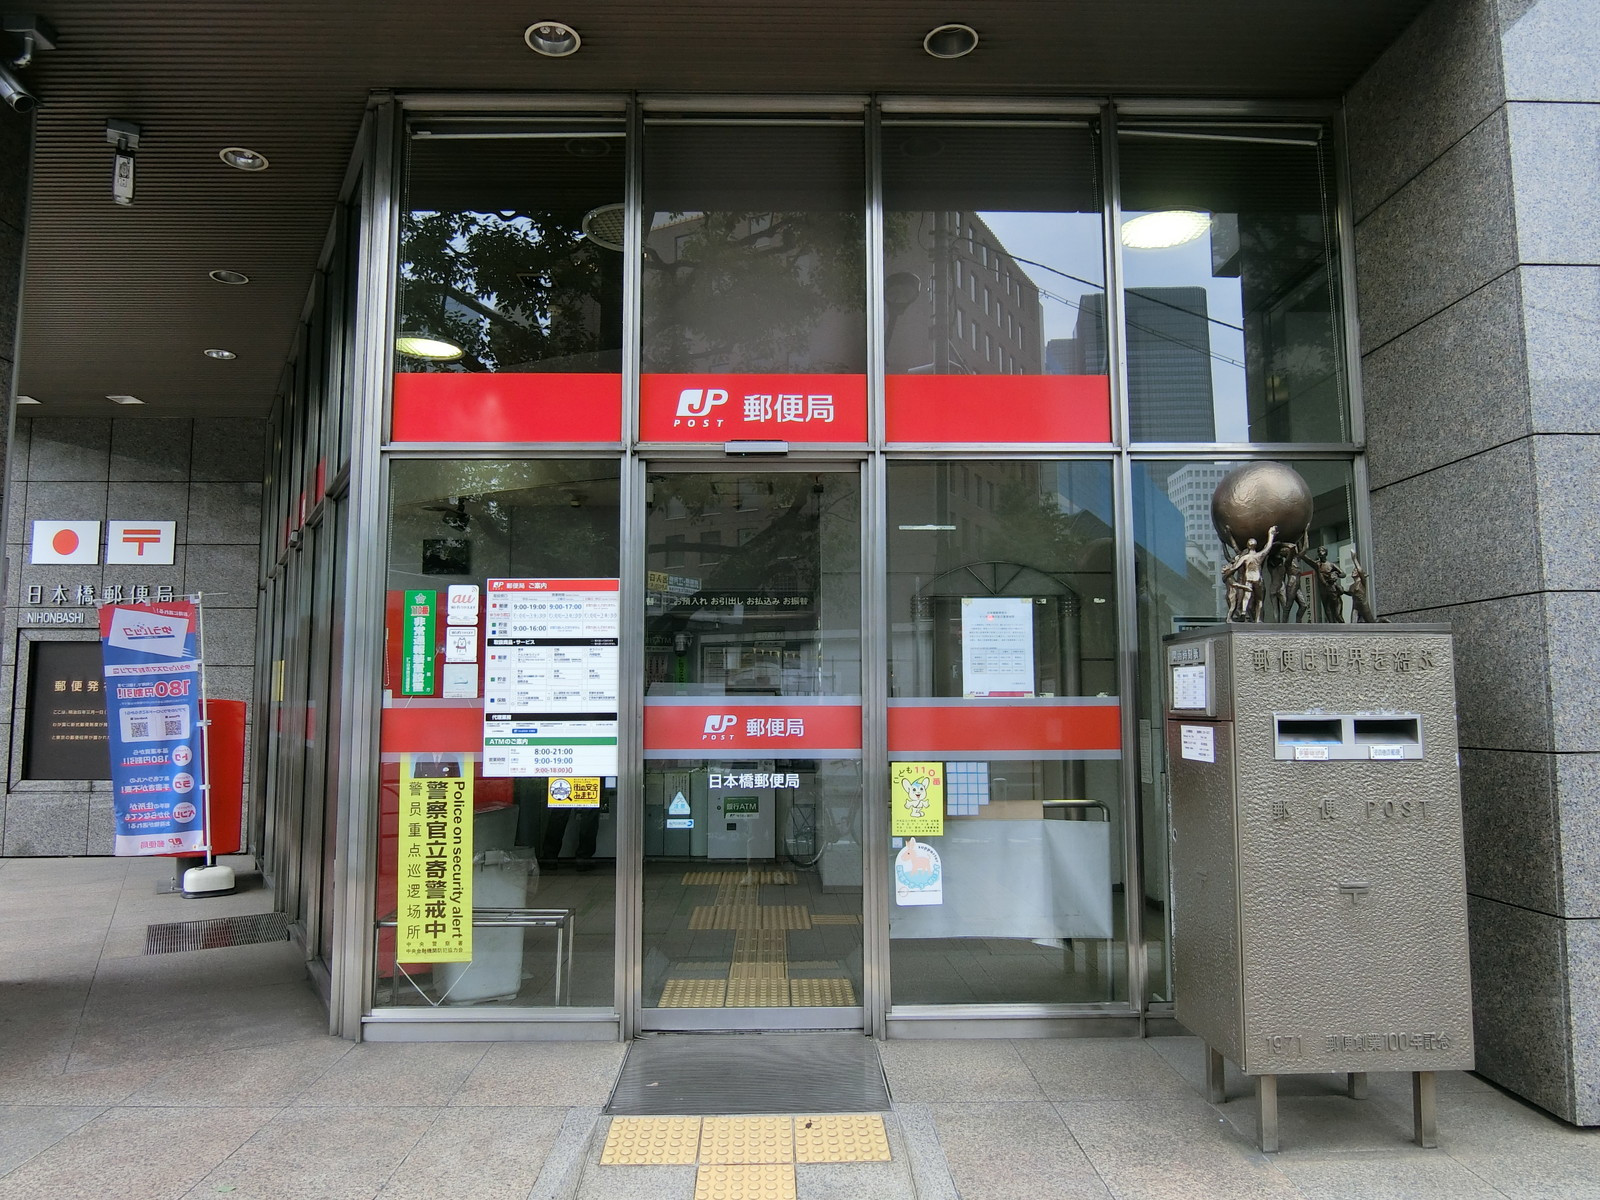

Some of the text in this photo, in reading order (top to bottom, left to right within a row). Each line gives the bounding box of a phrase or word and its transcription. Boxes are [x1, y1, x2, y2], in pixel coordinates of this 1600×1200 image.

[743, 394, 835, 423] 郵便局
[673, 419, 725, 428] POST
[27, 584, 174, 605] 日本橋郵便局
[452, 594, 475, 604] au
[673, 597, 707, 606] お預入れ
[711, 597, 744, 606] お引出し
[747, 596, 780, 606] お払込み
[783, 596, 808, 605] お振替
[27, 612, 85, 624] NIHONBASHI
[1251, 646, 1435, 673] 郵便は世界を結ぶ
[54, 680, 107, 692] 郵便発
[746, 718, 805, 738] 郵便局
[534, 748, 573, 756] 8:00-21:00
[534, 757, 573, 765] 9:00-19:00
[708, 773, 801, 789] 日本橋郵便局
[1366, 800, 1429, 819] POST
[406, 781, 423, 939] 警员重点巡逻场所
[424, 781, 449, 939] 警察官立寄警戒中
[449, 781, 466, 939] Police on security alert
